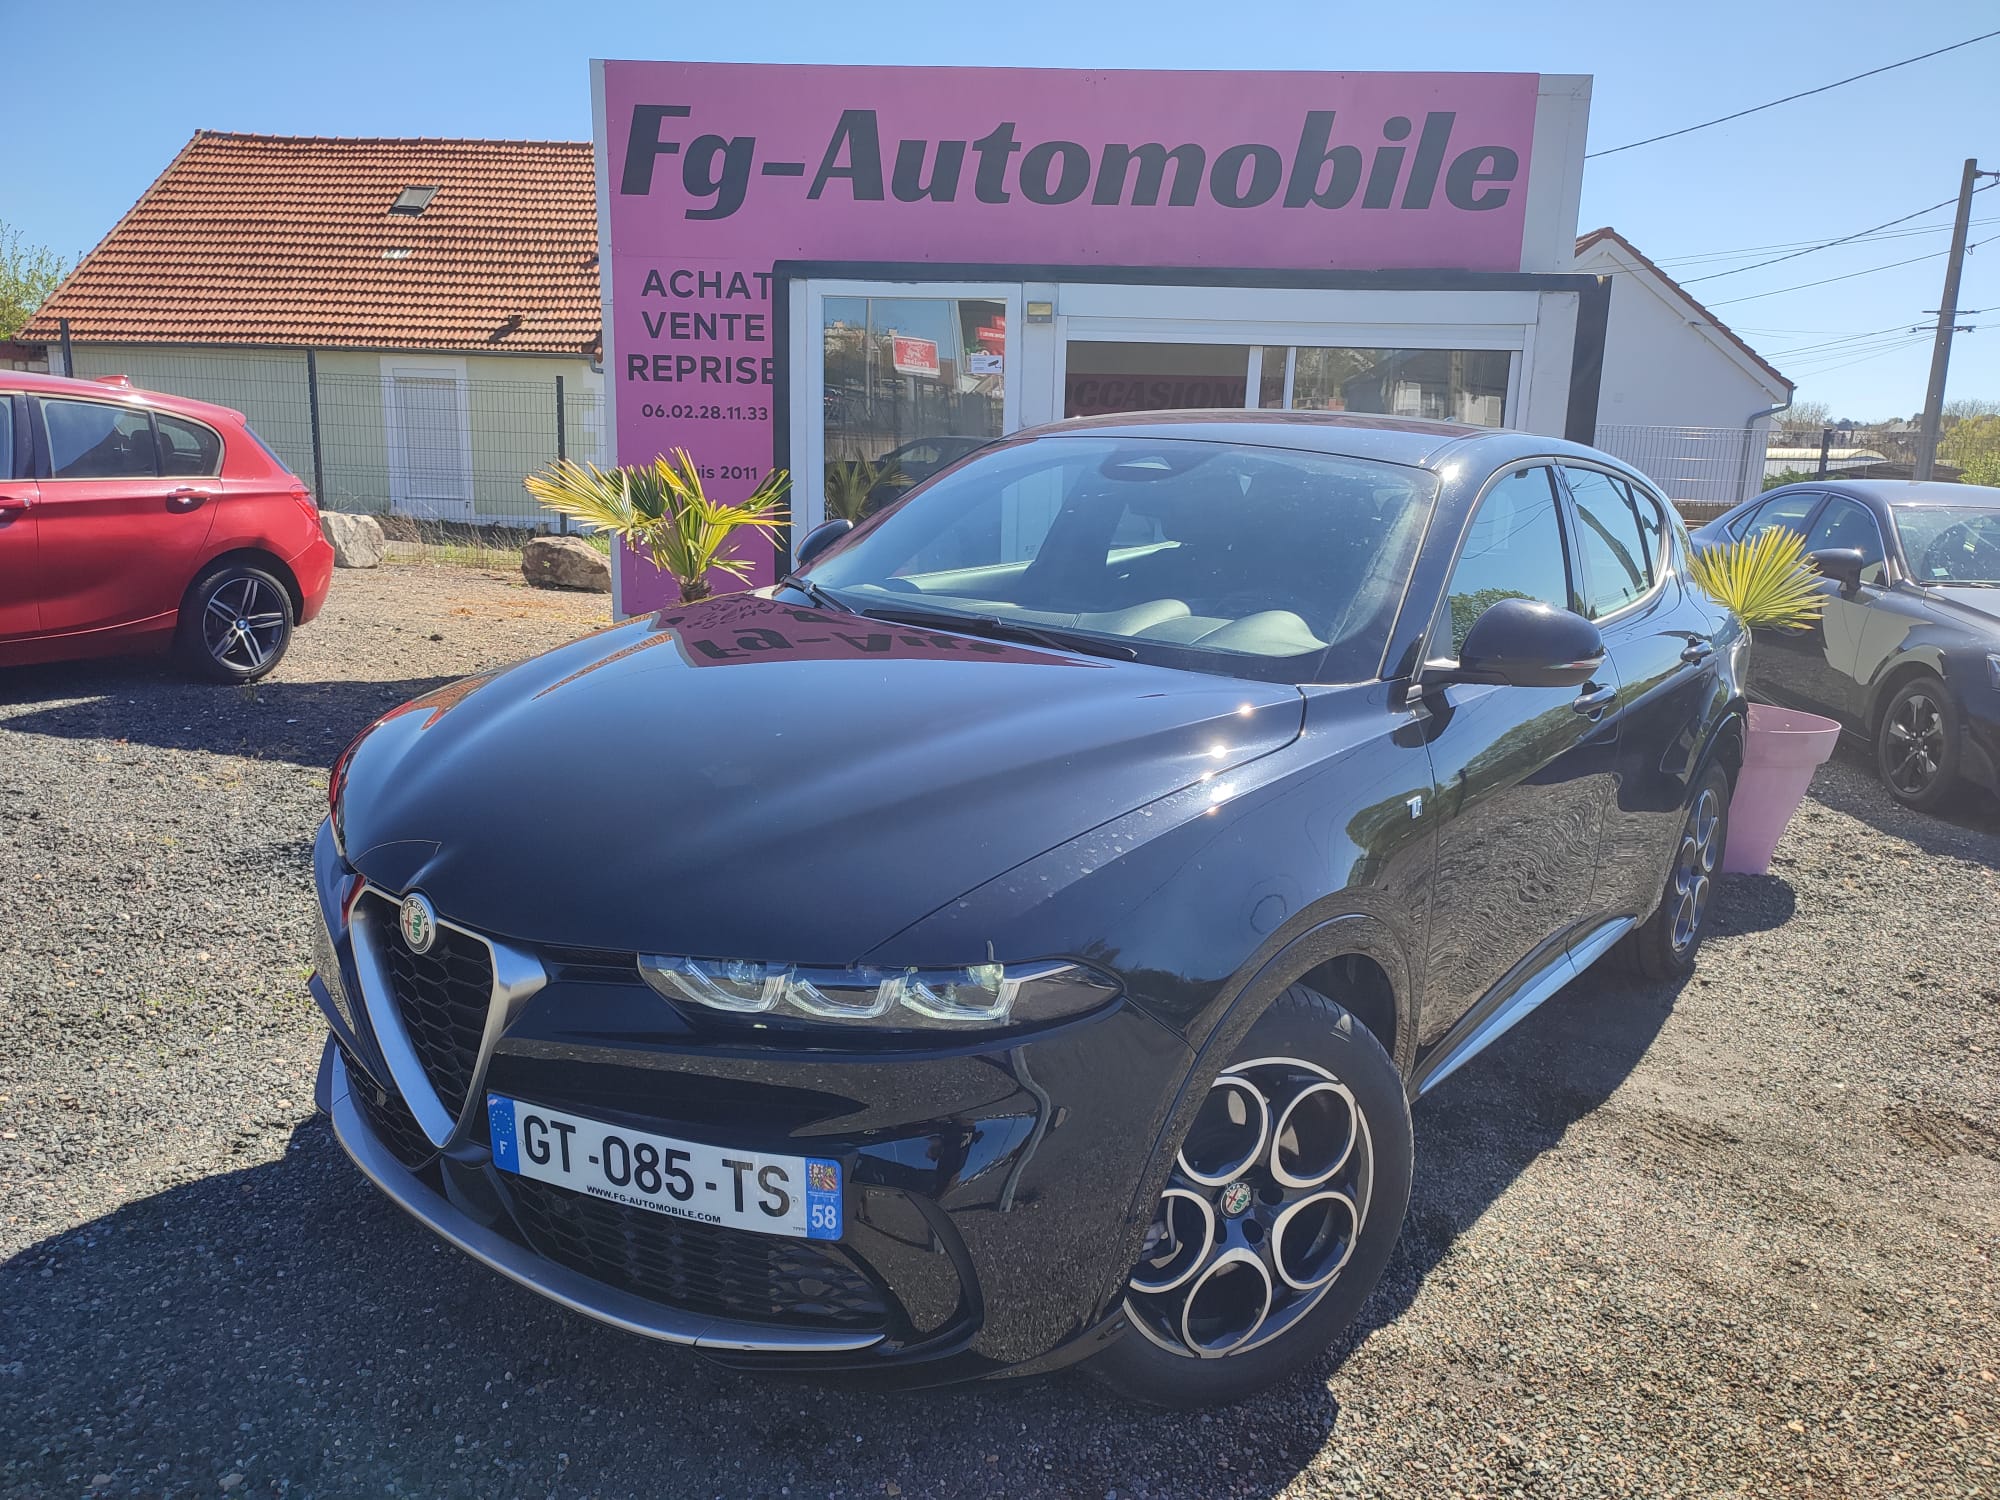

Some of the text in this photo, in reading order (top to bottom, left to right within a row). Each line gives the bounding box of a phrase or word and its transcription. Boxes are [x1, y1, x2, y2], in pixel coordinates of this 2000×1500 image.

[620, 104, 1519, 220] Fg-Automobile
[641, 269, 773, 299] ACHAT
[641, 311, 765, 341] VENTE
[627, 354, 776, 385] REPRISE
[1067, 380, 1240, 408] CCASION
[642, 404, 768, 420] 06.02.28.11.33
[720, 466, 757, 480] 2011
[499, 1140, 508, 1155] F
[586, 1185, 720, 1223] WWW.FG-AUTOMOBILE.COM
[811, 1204, 837, 1229] 58
